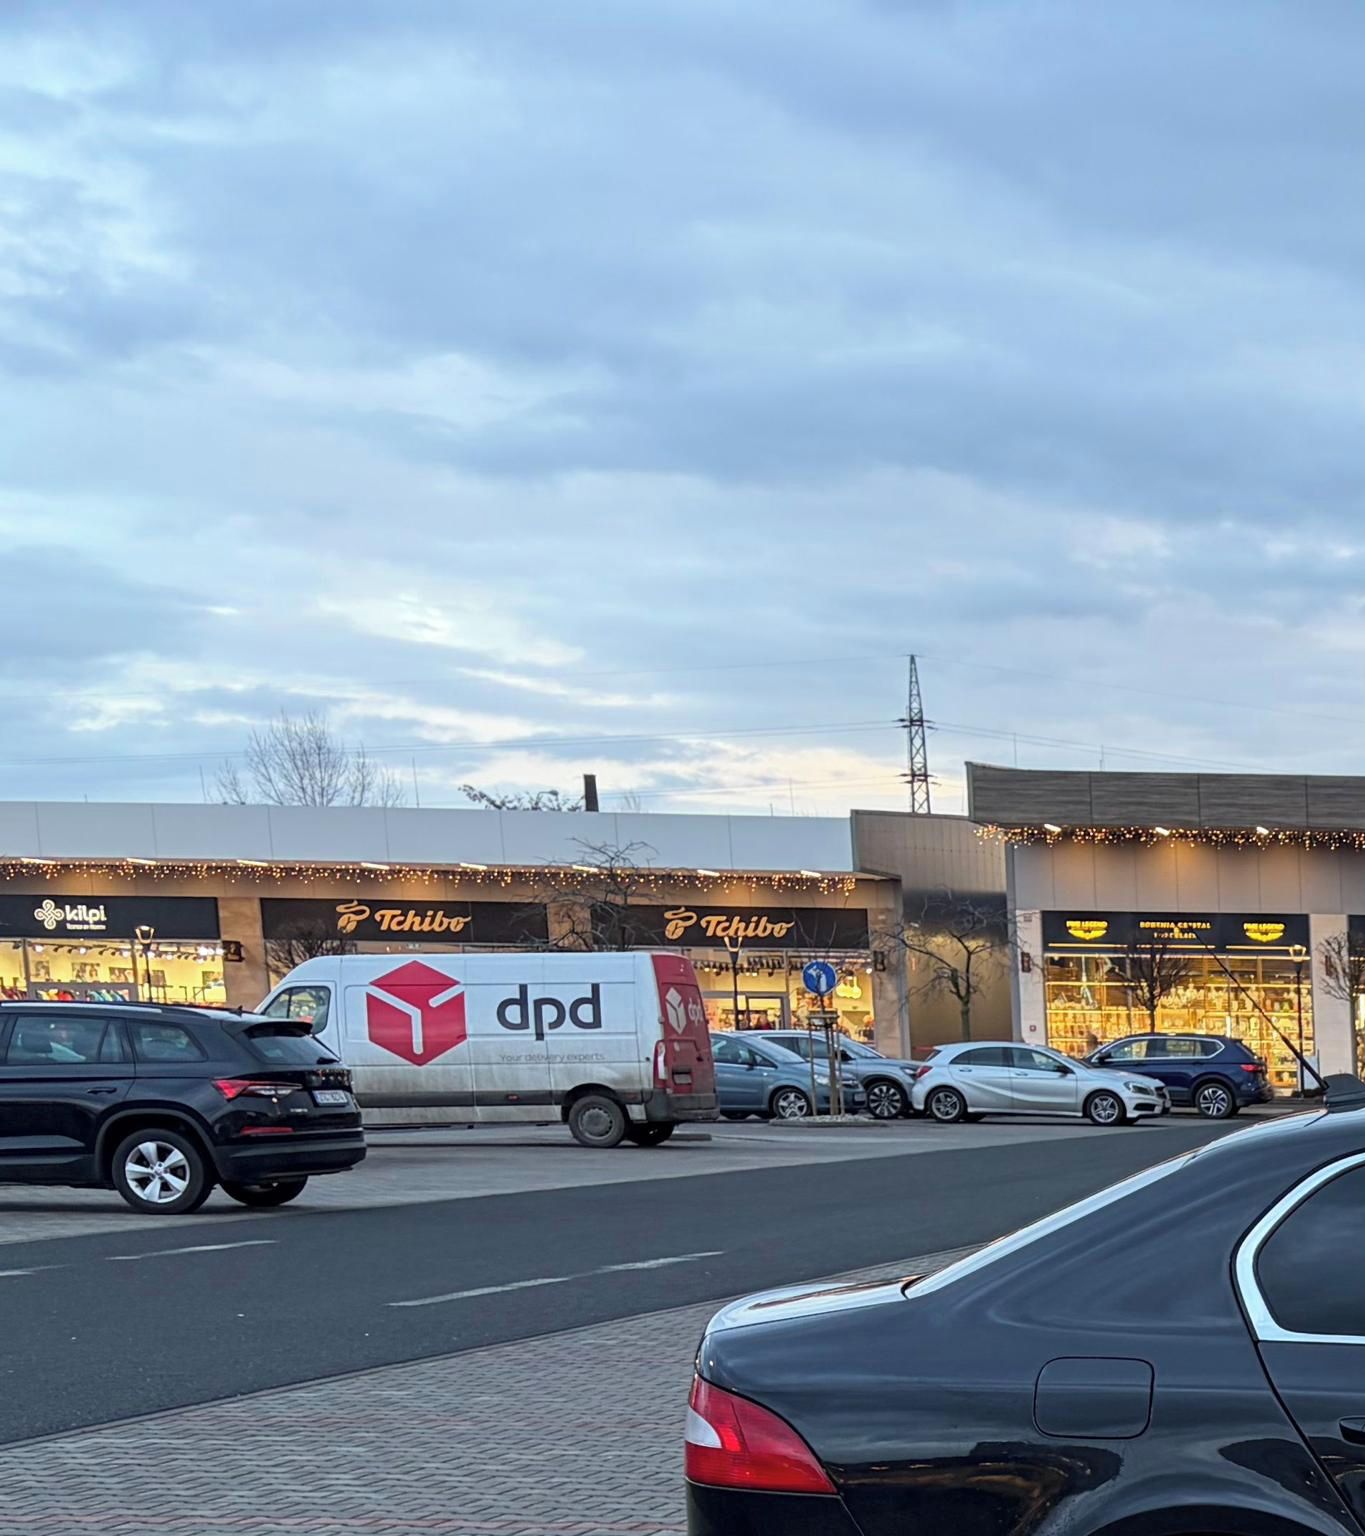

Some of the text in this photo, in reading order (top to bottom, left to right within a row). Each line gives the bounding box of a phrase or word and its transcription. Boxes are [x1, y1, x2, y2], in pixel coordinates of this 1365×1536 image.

[65, 905, 107, 924] kilpi
[374, 909, 472, 932] Tchibo
[700, 916, 795, 938] Tchibo
[496, 983, 602, 1041] dpd
